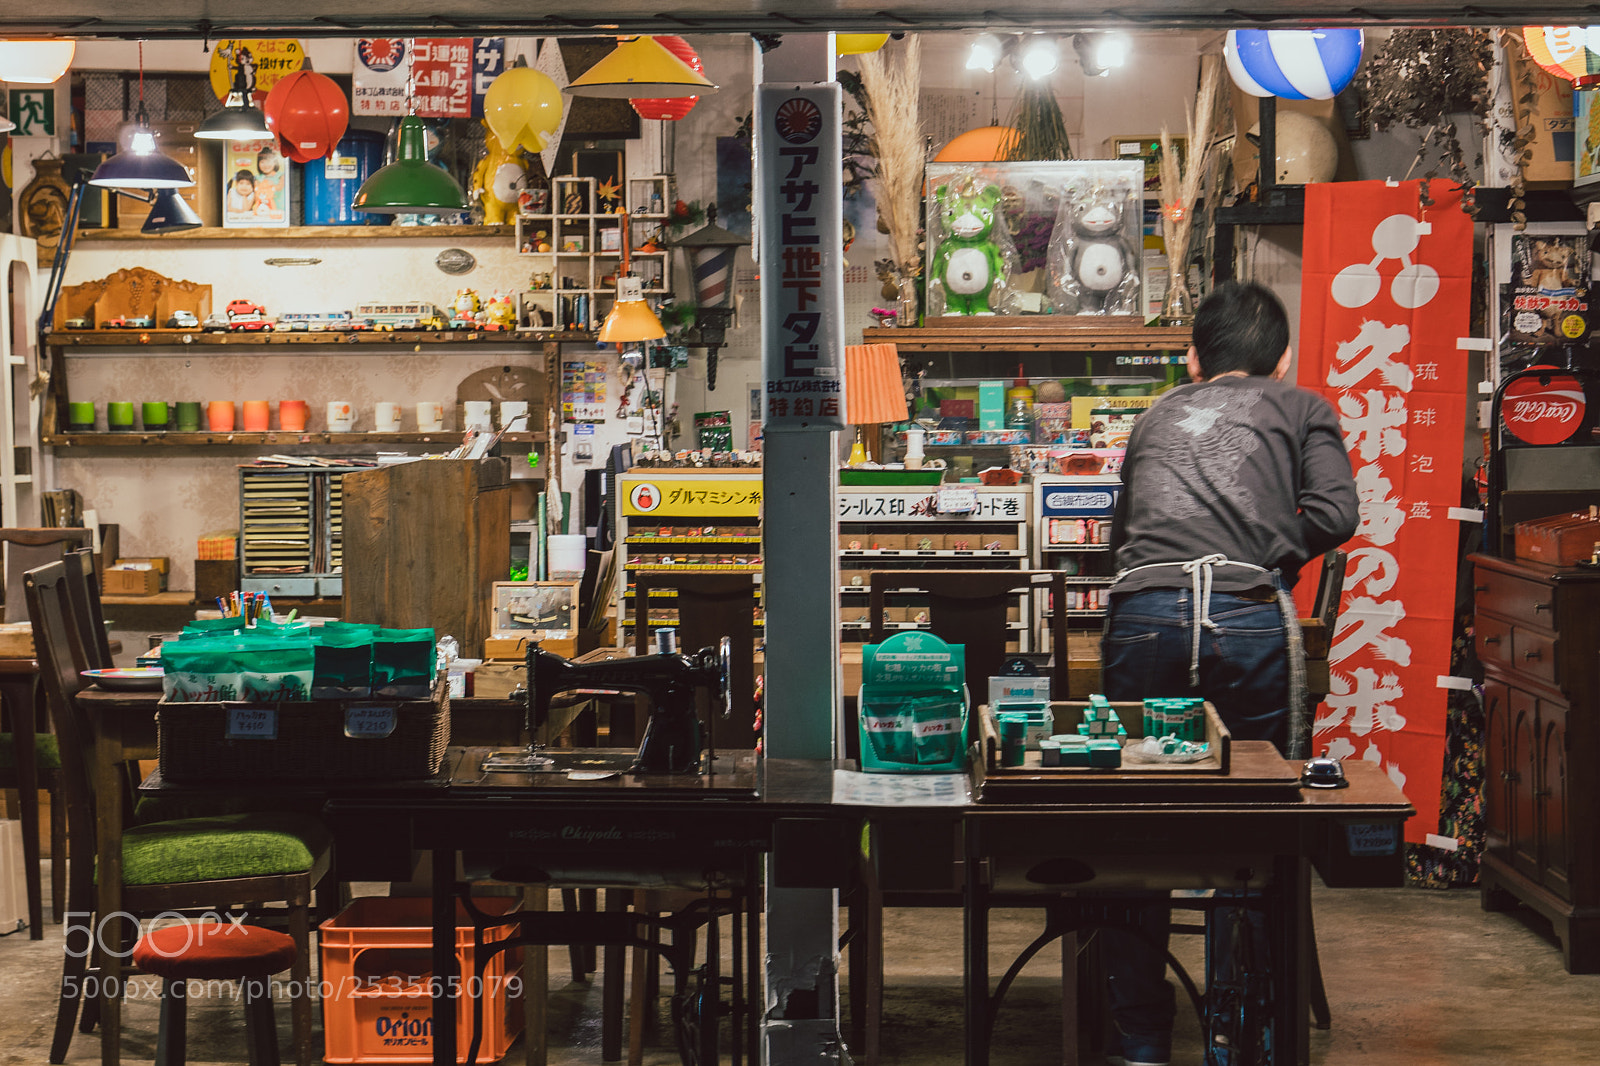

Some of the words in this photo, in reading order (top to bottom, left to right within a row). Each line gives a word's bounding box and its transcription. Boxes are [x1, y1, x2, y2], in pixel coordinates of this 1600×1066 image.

[450, 45, 468, 113] 地下タビ
[355, 87, 405, 97] 日本ゴム株式会社
[360, 100, 400, 111] 特約店
[779, 147, 821, 377] アサヒ地下タビ
[767, 379, 840, 394] 日本ゴム株式会社
[768, 397, 839, 417] 特約店
[1511, 401, 1577, 423] Coca-Cola
[1407, 361, 1439, 519] 琉球泡盛
[668, 487, 762, 505] ダルマミシン糸
[356, 720, 388, 731] ¥210
[376, 1012, 434, 1037] Orion
[383, 1038, 429, 1046] オリオンビール
